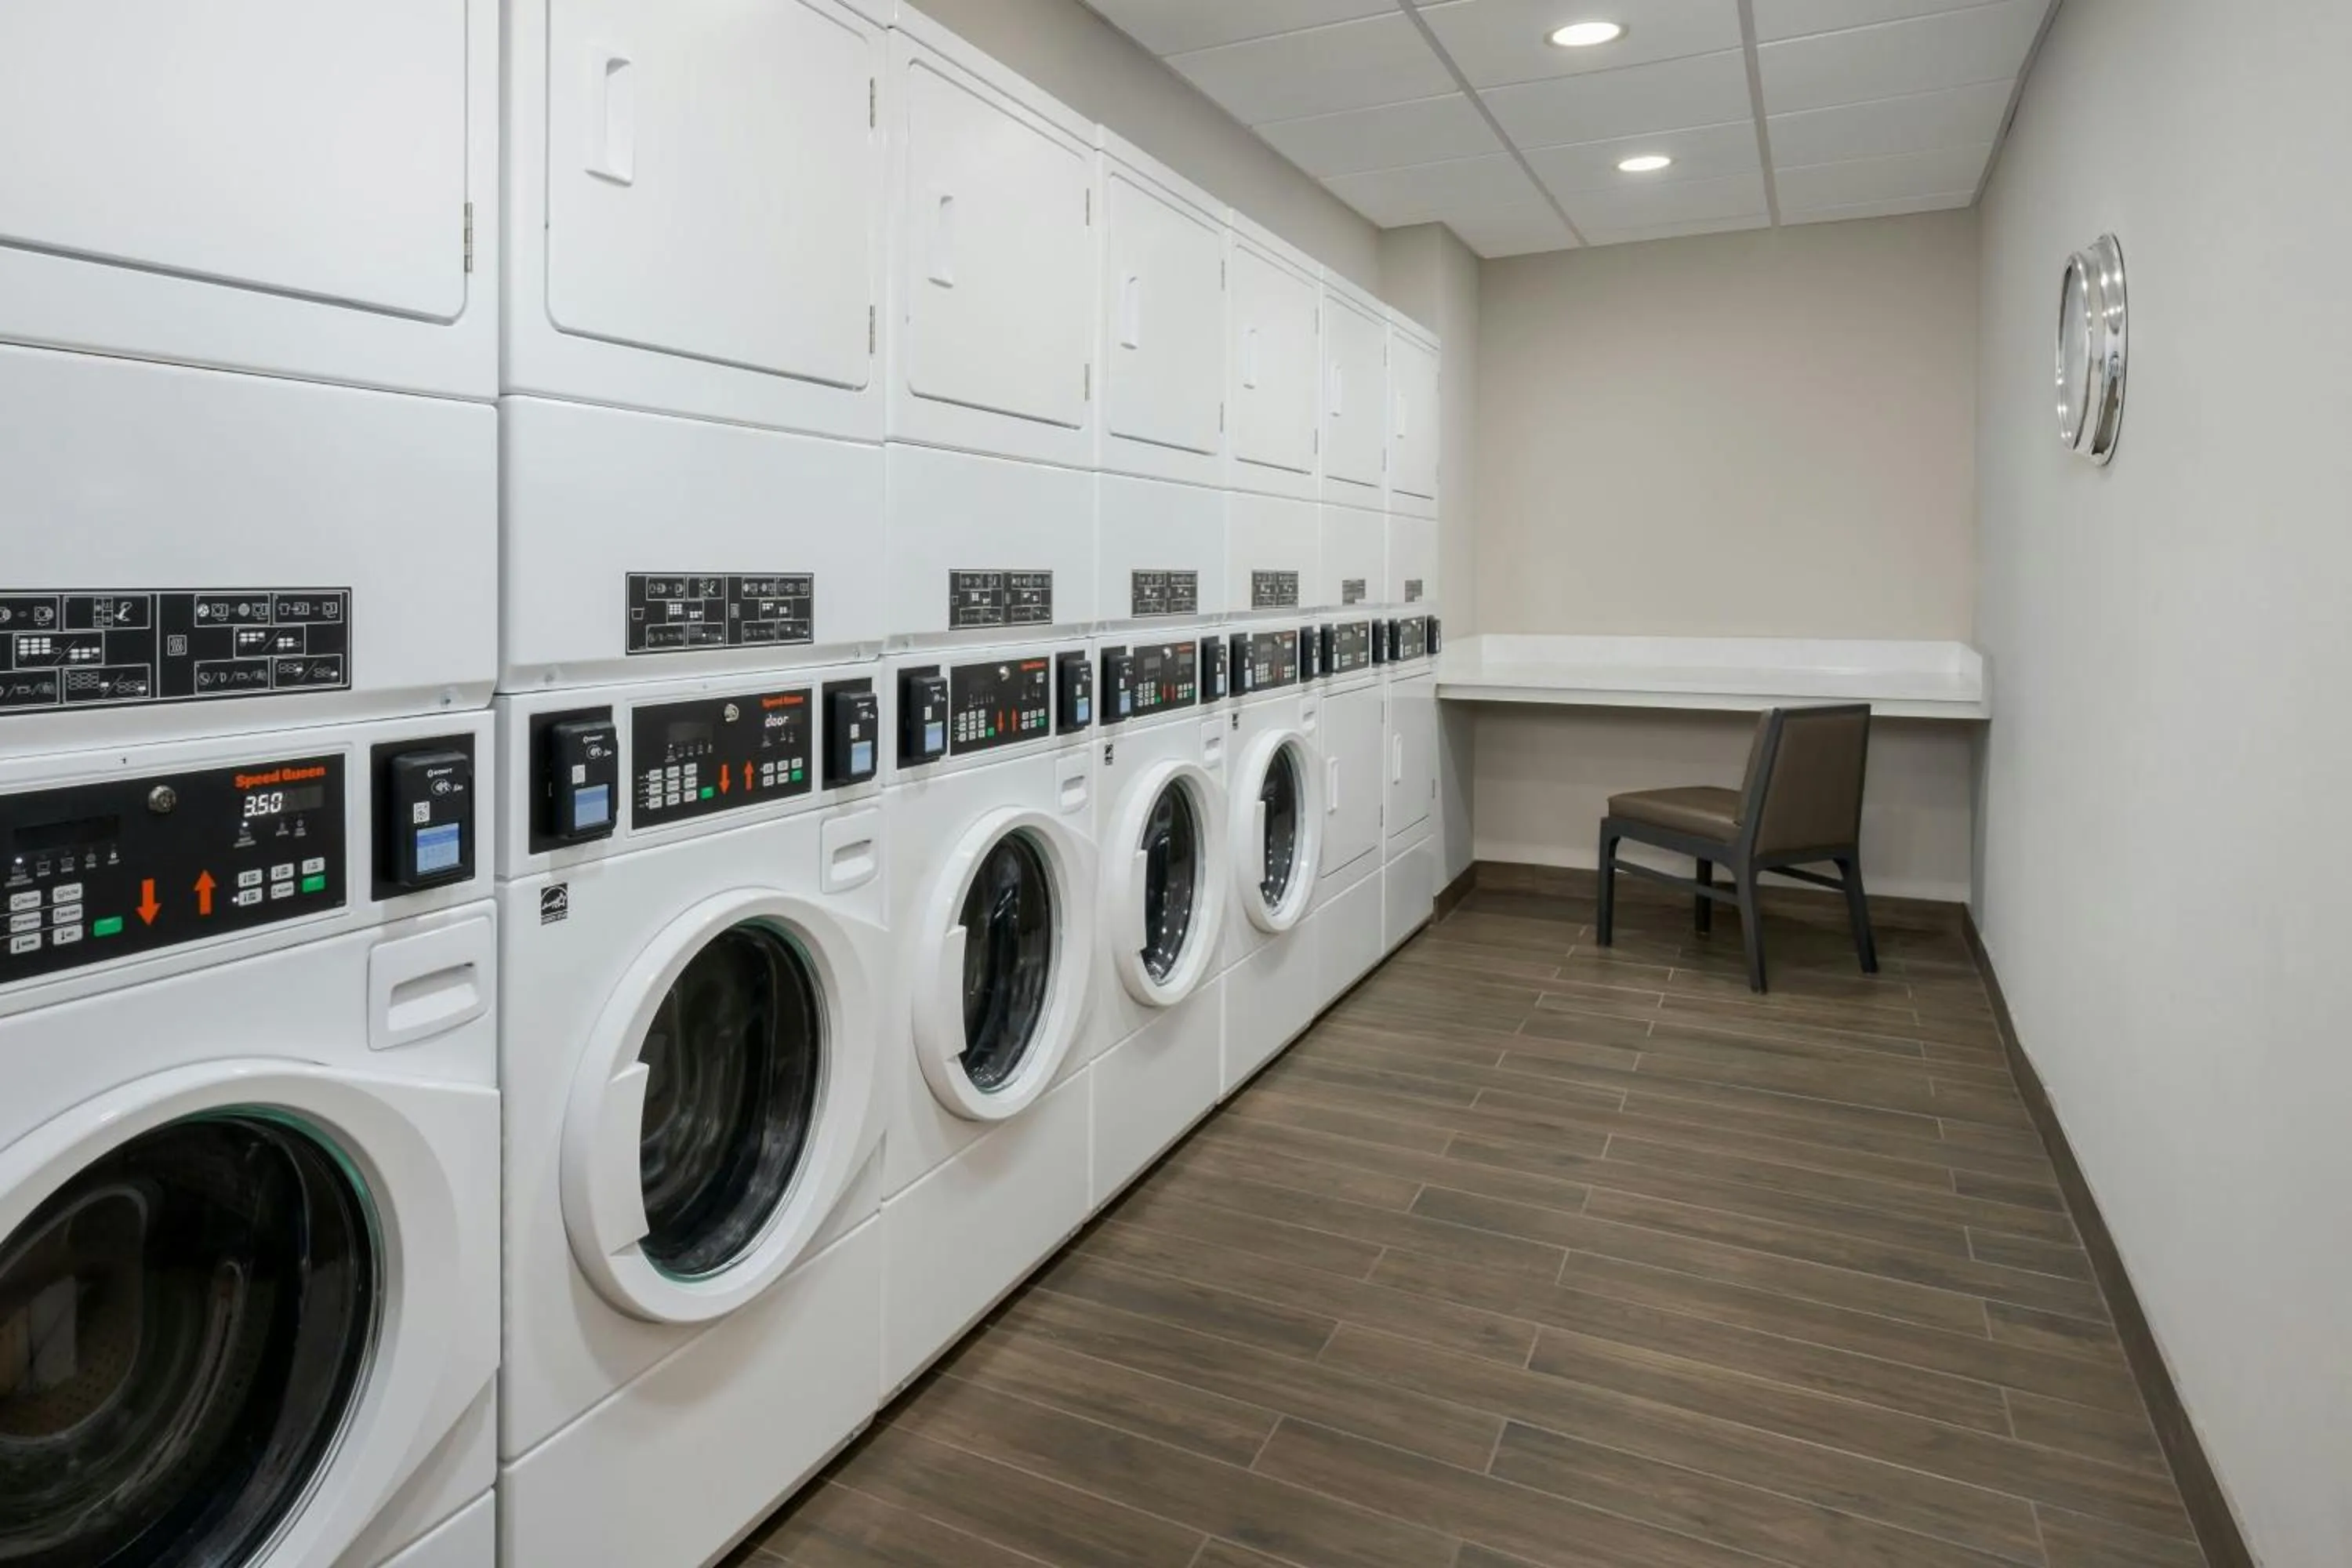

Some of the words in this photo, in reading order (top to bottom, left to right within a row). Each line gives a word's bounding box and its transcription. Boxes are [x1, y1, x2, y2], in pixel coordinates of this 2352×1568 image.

[765, 714, 789, 728] door
[235, 769, 280, 789] Speed
[281, 766, 325, 780] Queen
